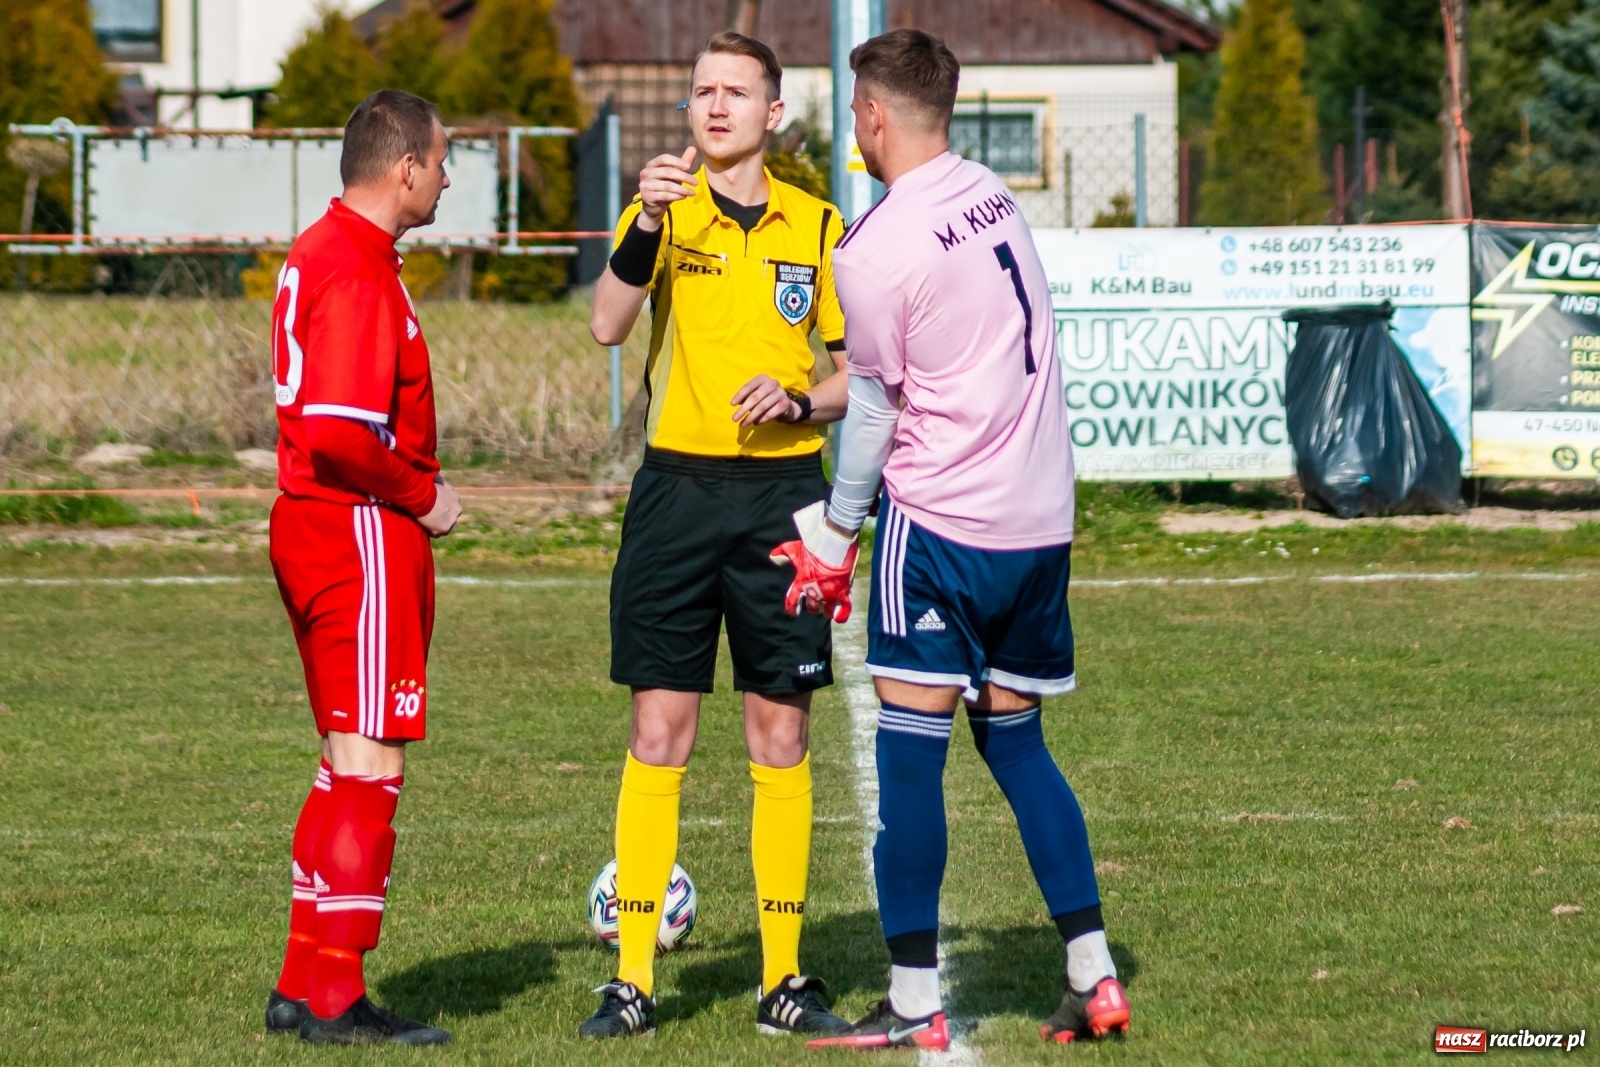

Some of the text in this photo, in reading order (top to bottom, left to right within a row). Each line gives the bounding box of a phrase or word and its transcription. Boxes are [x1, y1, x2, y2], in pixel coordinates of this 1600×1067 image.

[932, 189, 1017, 251] M. KUHN
[1250, 236, 1402, 252] +48 607 543 236
[779, 264, 813, 276] KOLEGIUM
[1250, 258, 1435, 275] +49 151 21 31 81 99
[1536, 241, 1600, 279] OC
[1049, 276, 1192, 295] au K&M Bau
[993, 240, 1037, 376] 1
[1560, 294, 1600, 316] INS
[1064, 371, 1287, 410] COWNIKÓ
[1069, 415, 1290, 447] OWLANYC
[1523, 418, 1600, 432] 47-450 N
[1075, 453, 1129, 471] RACY
[915, 621, 946, 631] adidas
[395, 691, 420, 718] 20
